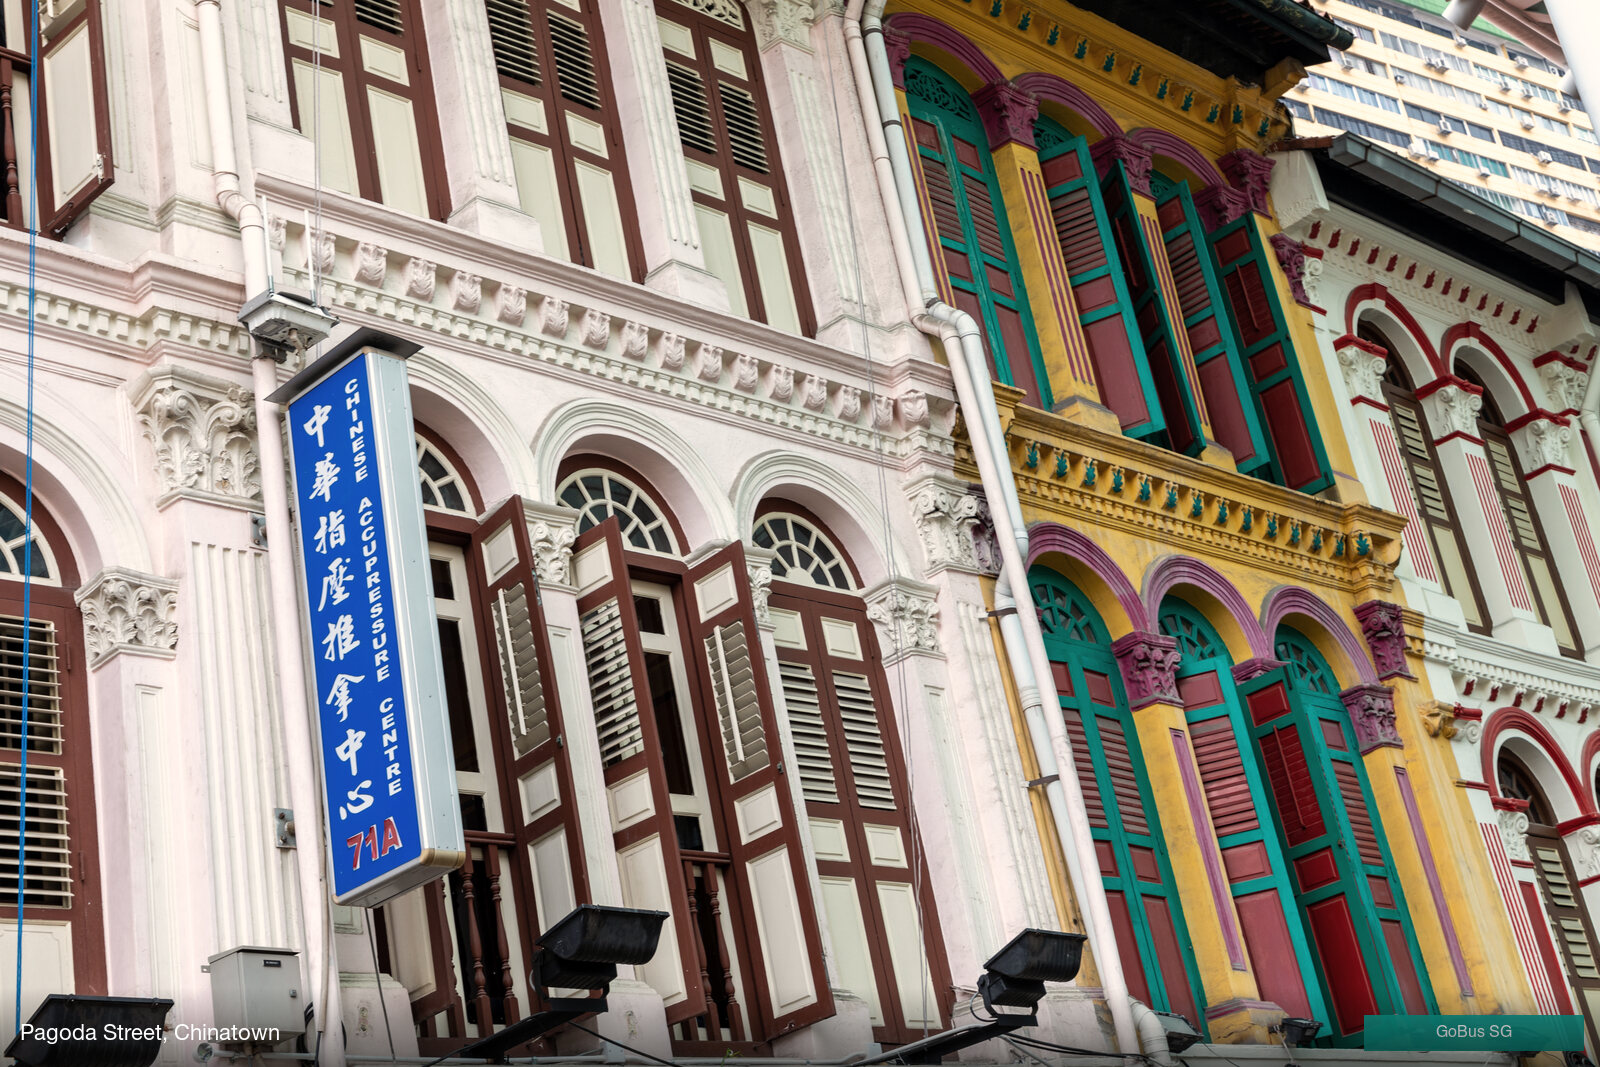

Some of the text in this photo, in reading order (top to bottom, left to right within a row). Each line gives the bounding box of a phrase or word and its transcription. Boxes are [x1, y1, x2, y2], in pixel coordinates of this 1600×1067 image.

[303, 404, 375, 822] 中華指壓推拿中心
[344, 378, 402, 796] CHINESE ACCUPRESSURE CENTRE
[347, 816, 403, 871] 71A
